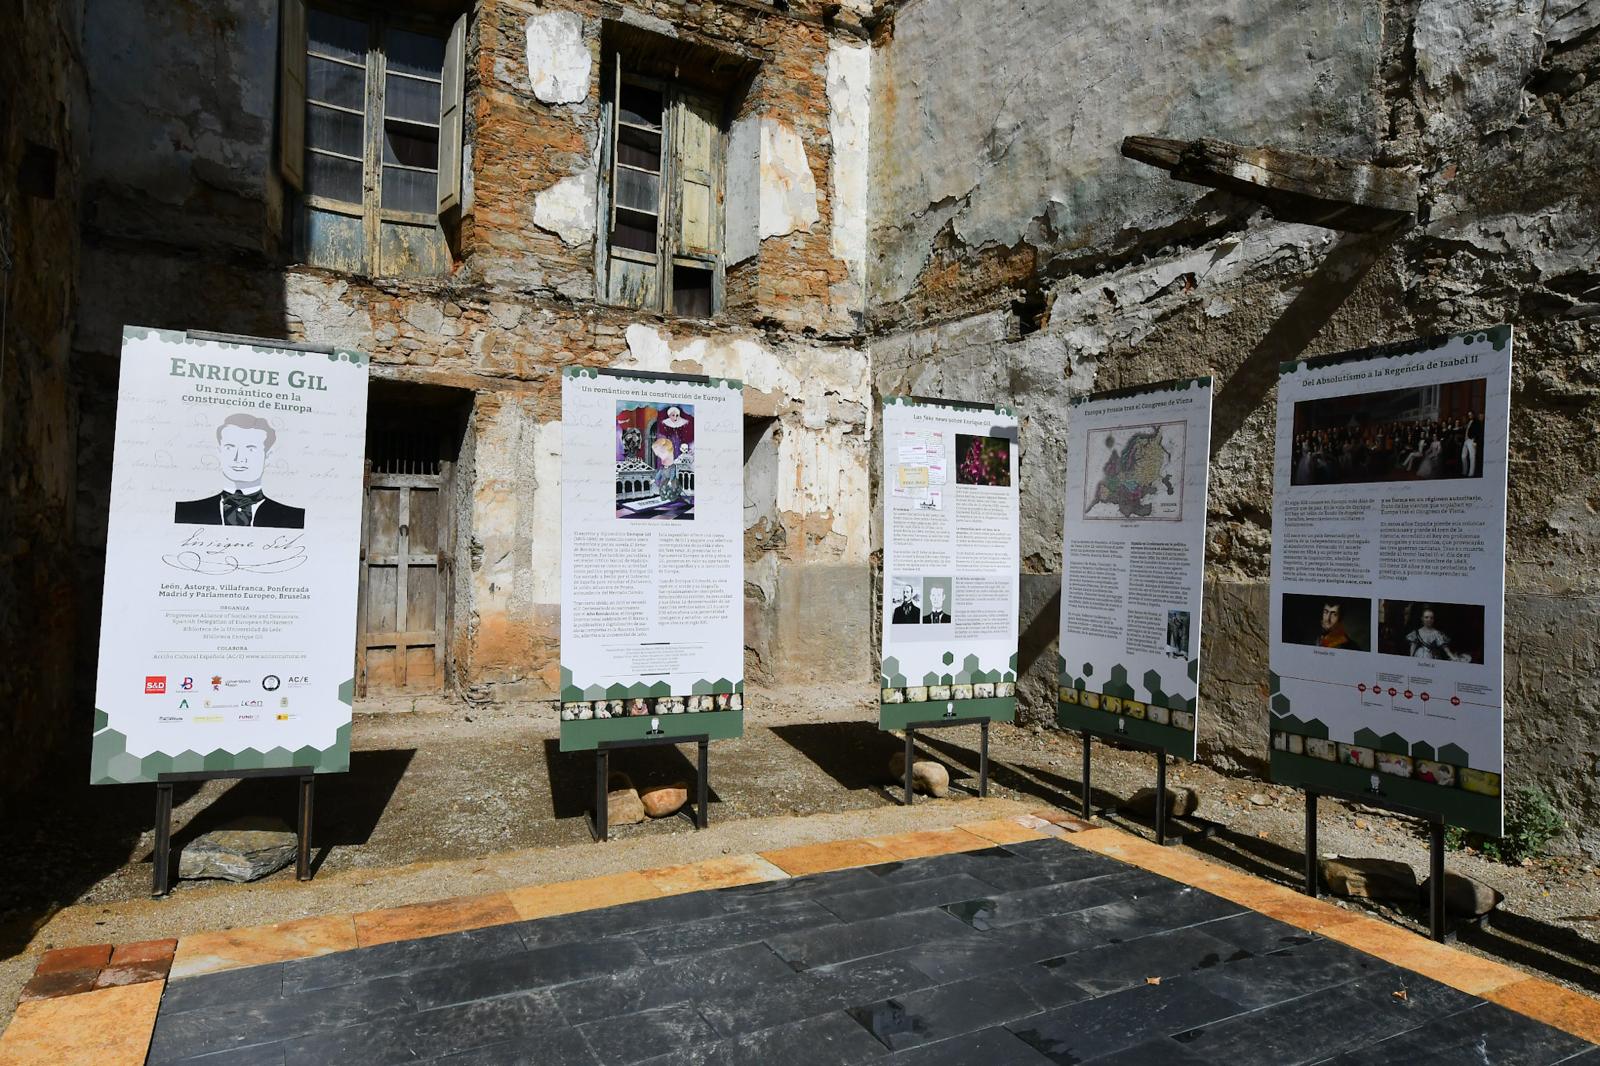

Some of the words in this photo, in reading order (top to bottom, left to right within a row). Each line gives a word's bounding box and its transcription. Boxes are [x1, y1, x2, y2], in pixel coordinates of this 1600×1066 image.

[170, 358, 279, 386] ENRIQUE
[288, 370, 327, 391] GIL
[1316, 372, 1366, 385] Absolutismo
[1374, 369, 1382, 377] la
[1384, 364, 1425, 377] Regencia
[1427, 361, 1438, 369] de
[1440, 356, 1468, 368] Isabel
[1470, 355, 1478, 364] II
[196, 384, 211, 393] Un
[215, 386, 273, 399] romántico
[291, 393, 300, 401] la
[594, 386, 629, 395] romántico
[650, 391, 692, 400] construcción
[182, 394, 255, 408] construcción
[274, 402, 312, 413] Europa
